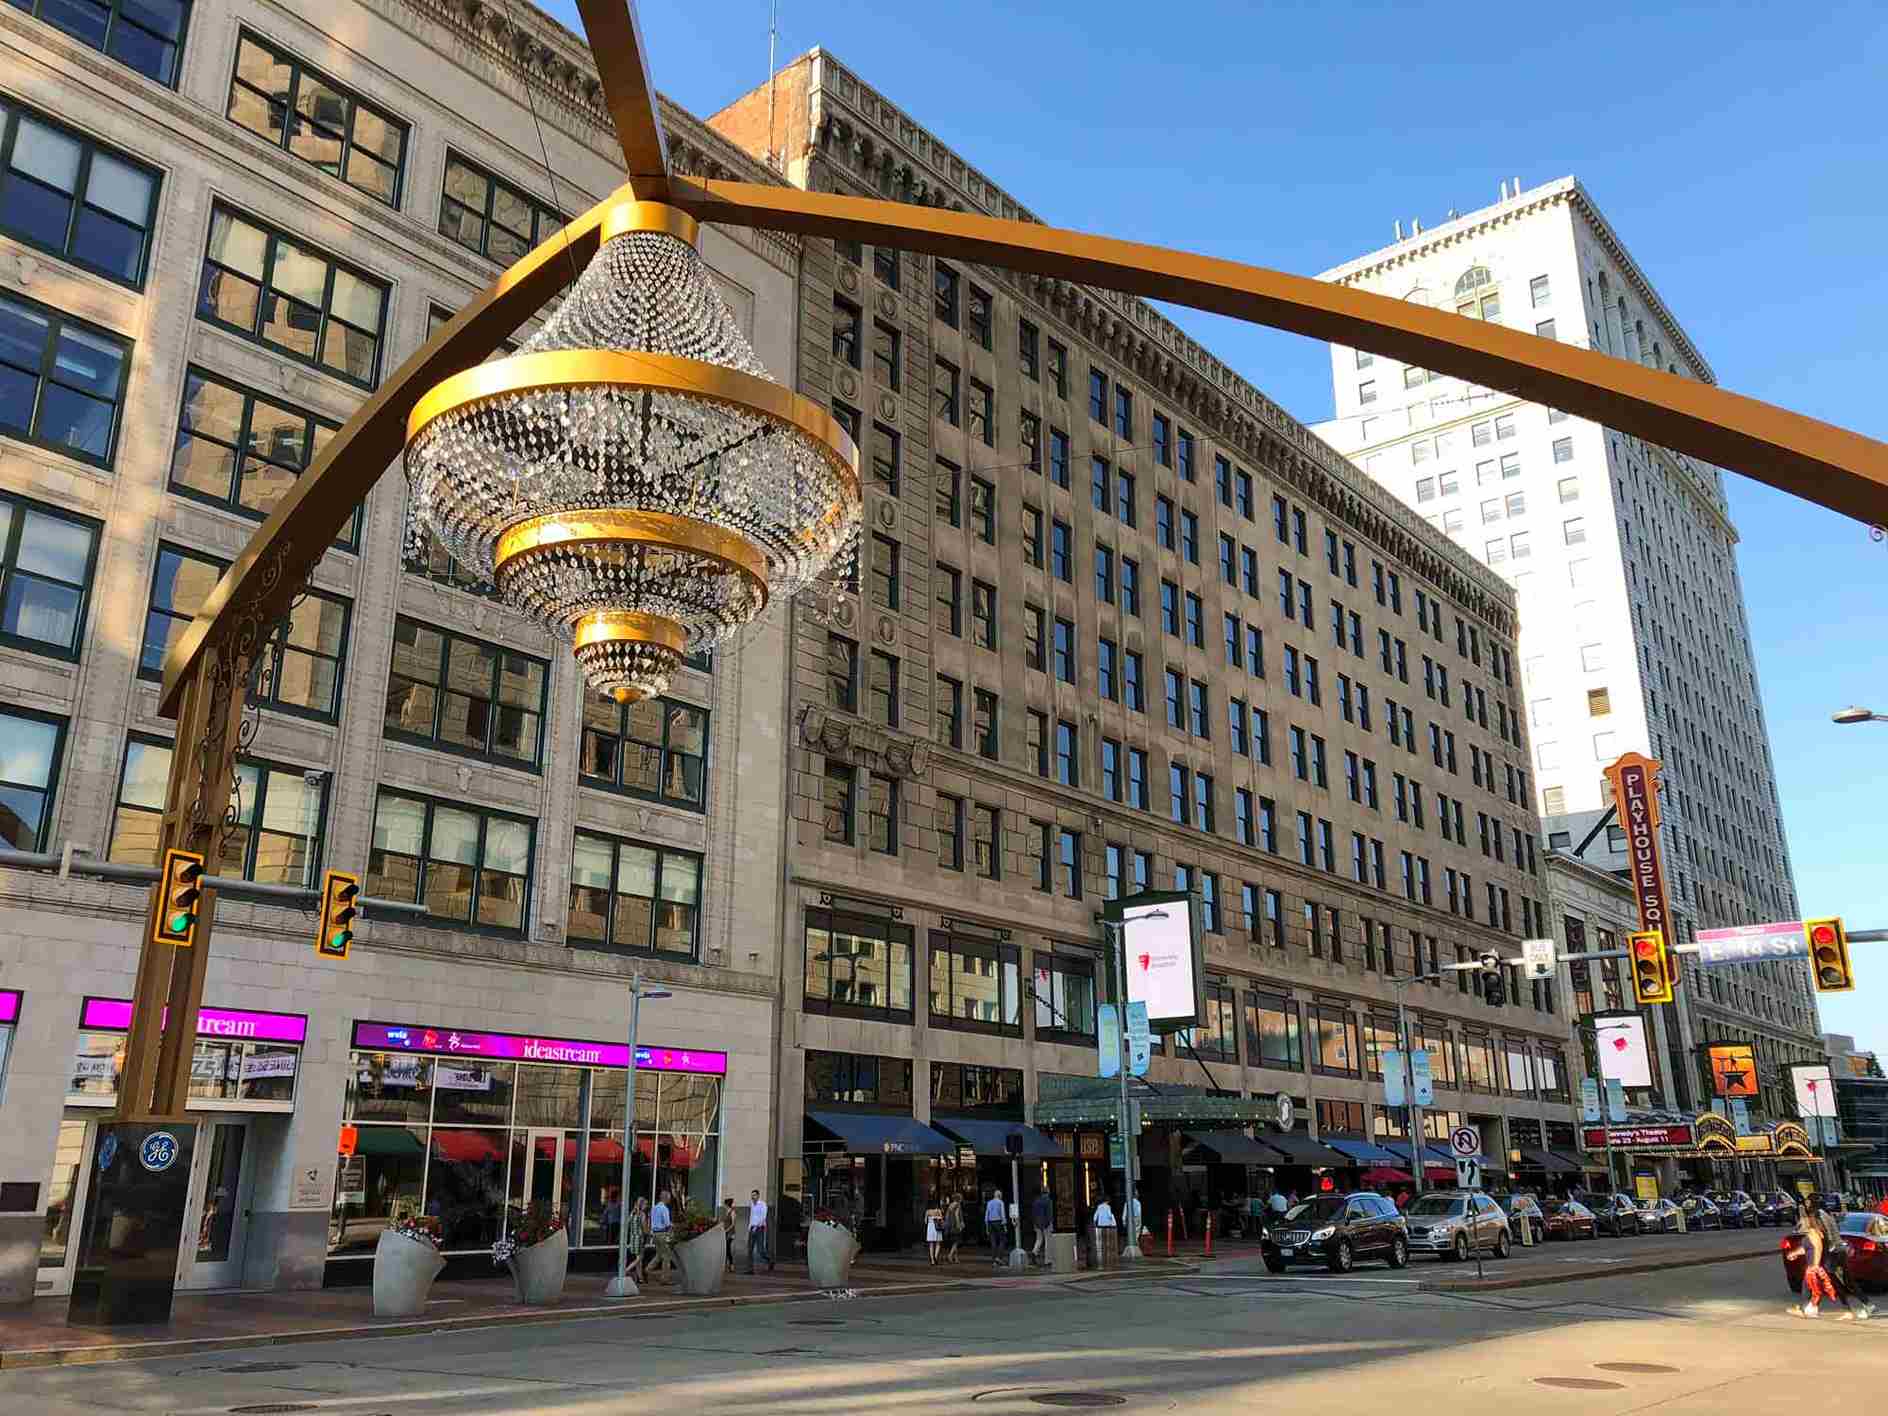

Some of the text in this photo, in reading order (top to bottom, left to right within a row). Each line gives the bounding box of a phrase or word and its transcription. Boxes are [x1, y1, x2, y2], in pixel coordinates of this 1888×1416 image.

[1626, 773, 1656, 888] PLAYHOUSE
[196, 1016, 256, 1037] tream
[523, 1039, 601, 1062] ideastream
